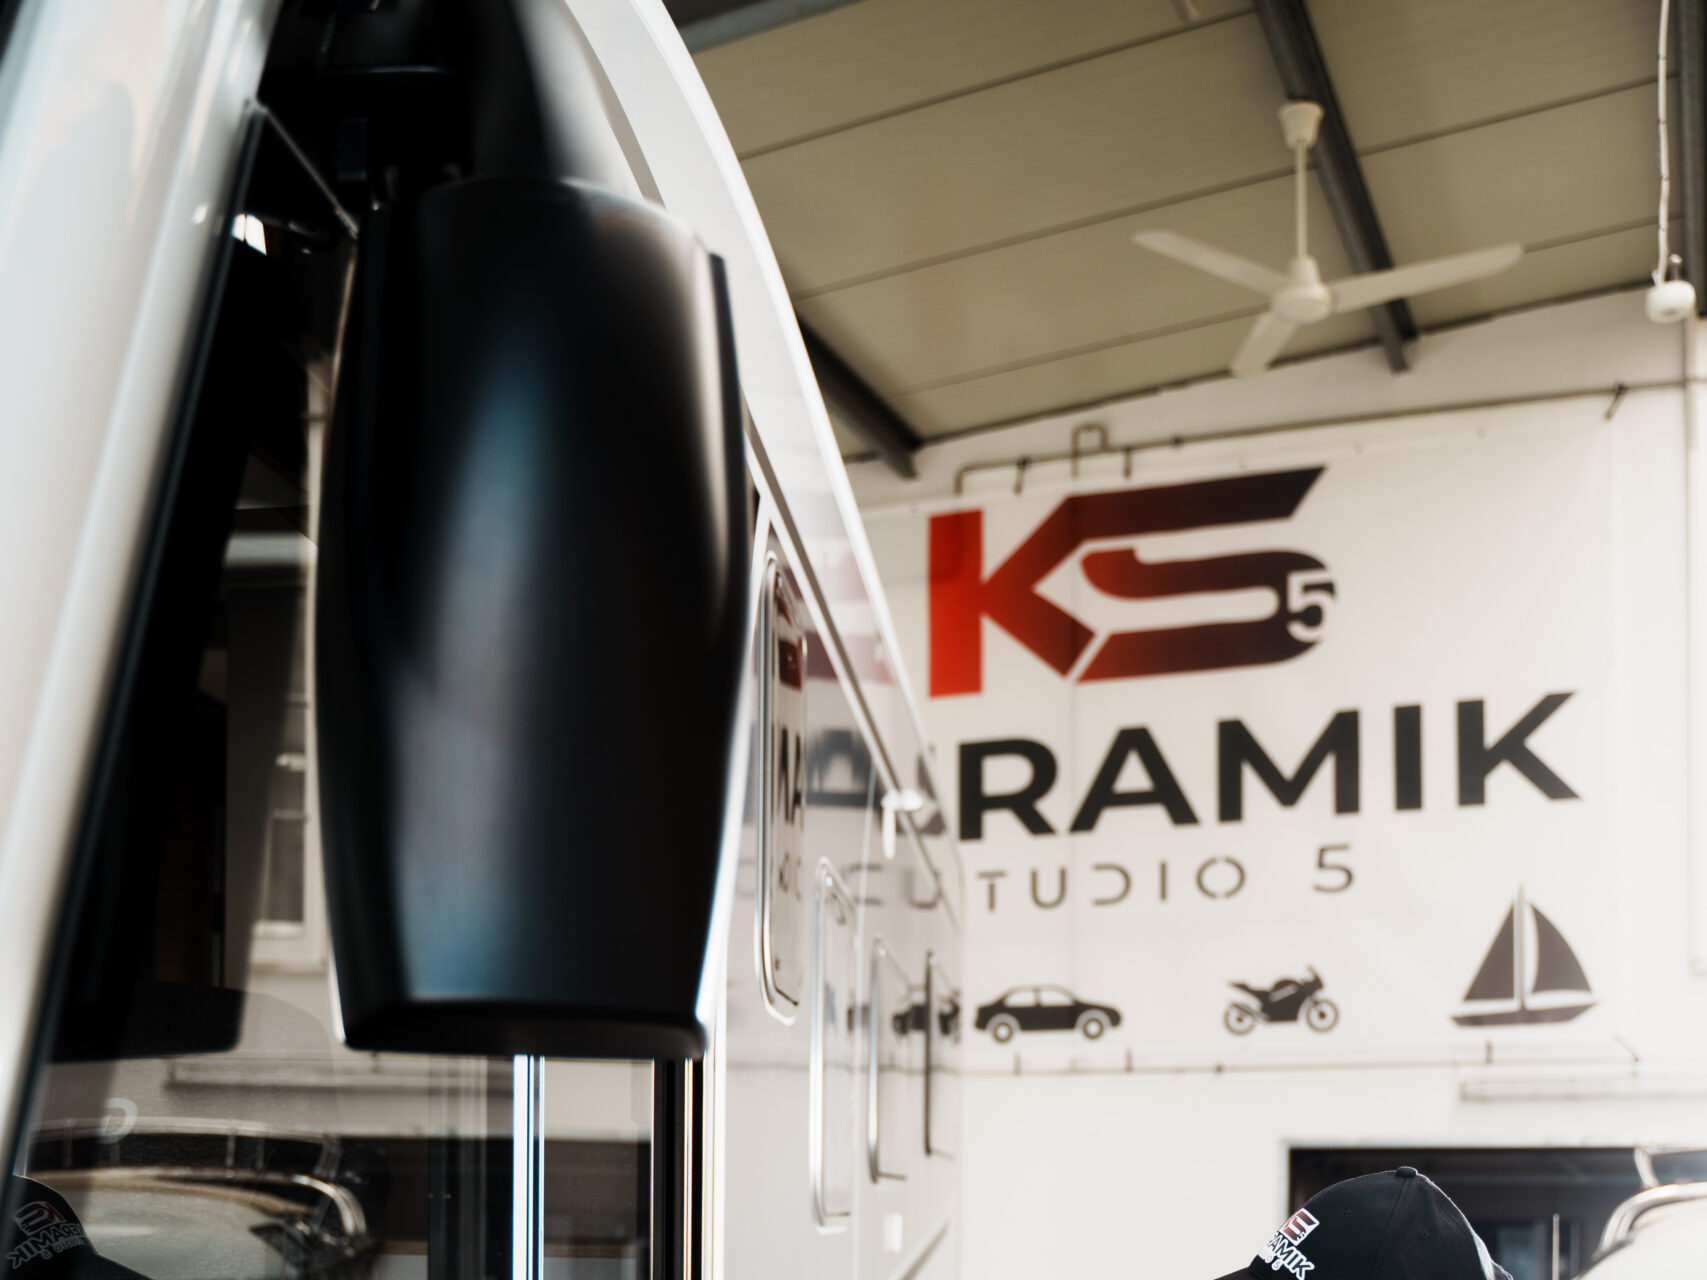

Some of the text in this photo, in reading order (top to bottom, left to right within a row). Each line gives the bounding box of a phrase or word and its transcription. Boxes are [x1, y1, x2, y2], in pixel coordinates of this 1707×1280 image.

[958, 691, 1582, 842] RAMIK
[976, 855, 1247, 913] TUDIO
[1313, 843, 1355, 894] 5
[1268, 1232, 1315, 1280] AMIK
